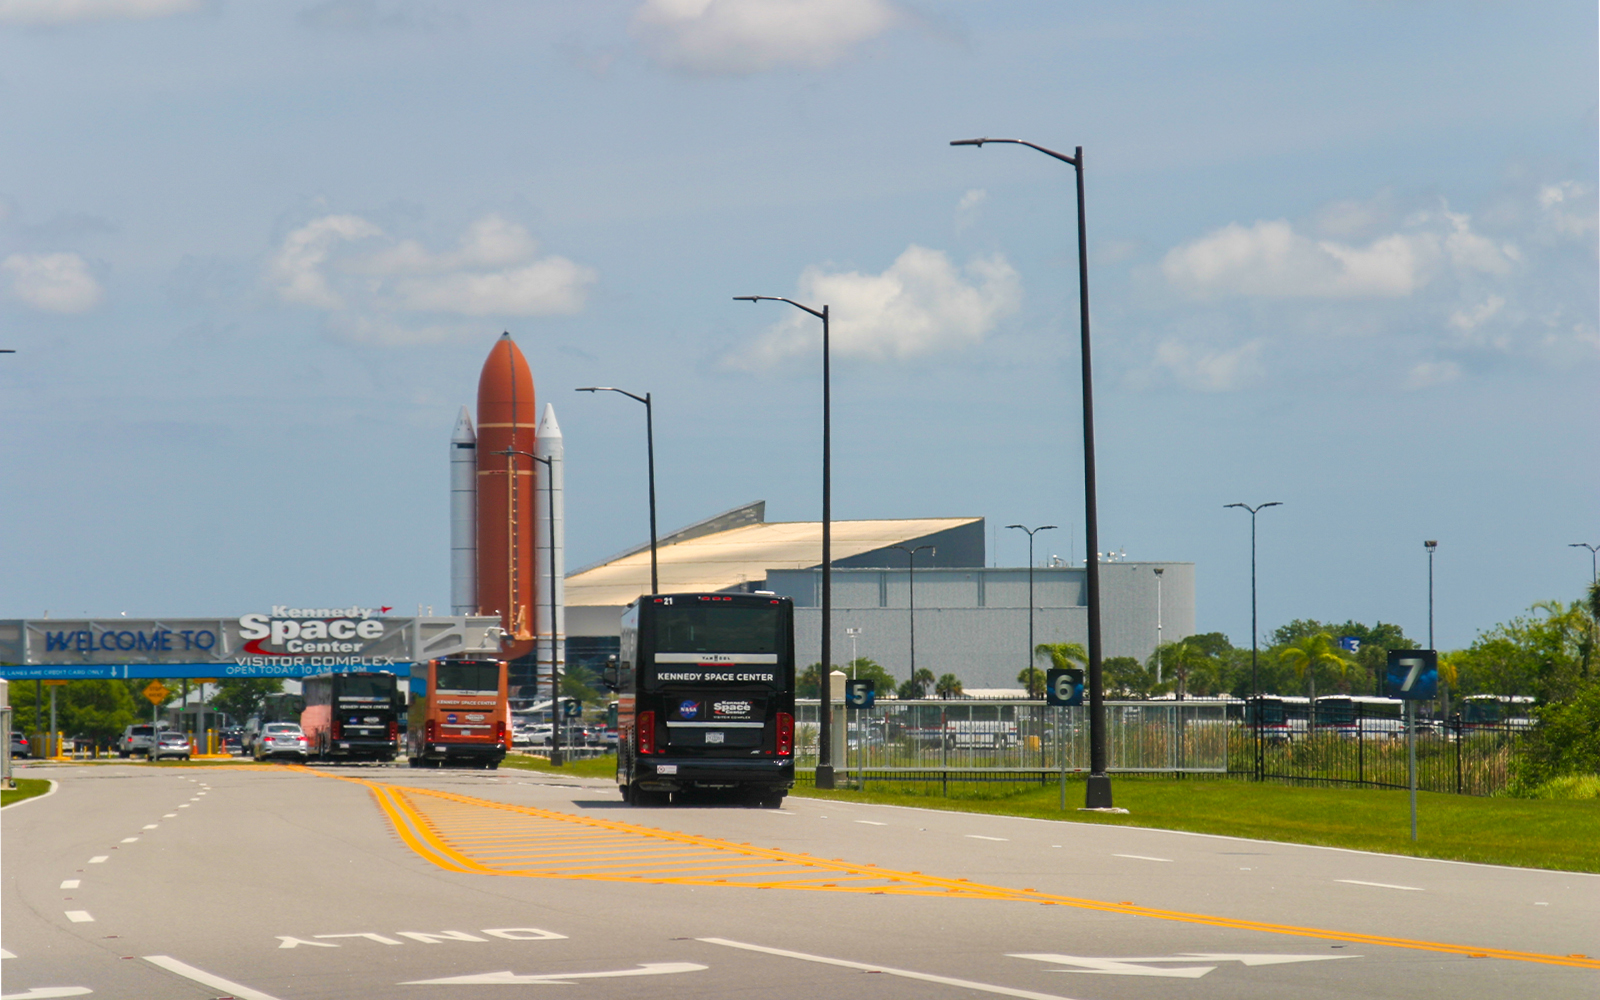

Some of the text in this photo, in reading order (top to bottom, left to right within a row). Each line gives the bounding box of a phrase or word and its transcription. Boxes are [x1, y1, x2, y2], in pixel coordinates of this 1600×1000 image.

[664, 597, 673, 605] 21
[272, 605, 373, 620] Kennedy
[238, 613, 385, 645] Space
[45, 629, 216, 651] WELCOME TO
[286, 639, 364, 653] Center
[1350, 640, 1360, 654] 3
[235, 656, 395, 667] VISITOR COMPLEX
[225, 666, 256, 675] OPEN
[258, 666, 298, 674] TODAY:
[301, 666, 313, 674] 10
[315, 666, 332, 674] AM
[704, 673, 735, 681] SPACE
[736, 673, 774, 681] CENTER
[1398, 658, 1425, 692] 7
[853, 684, 867, 705] 5
[1055, 674, 1074, 701] 6
[568, 702, 578, 715] 2
[713, 702, 751, 712] Space
[274, 928, 569, 949] ONLY
